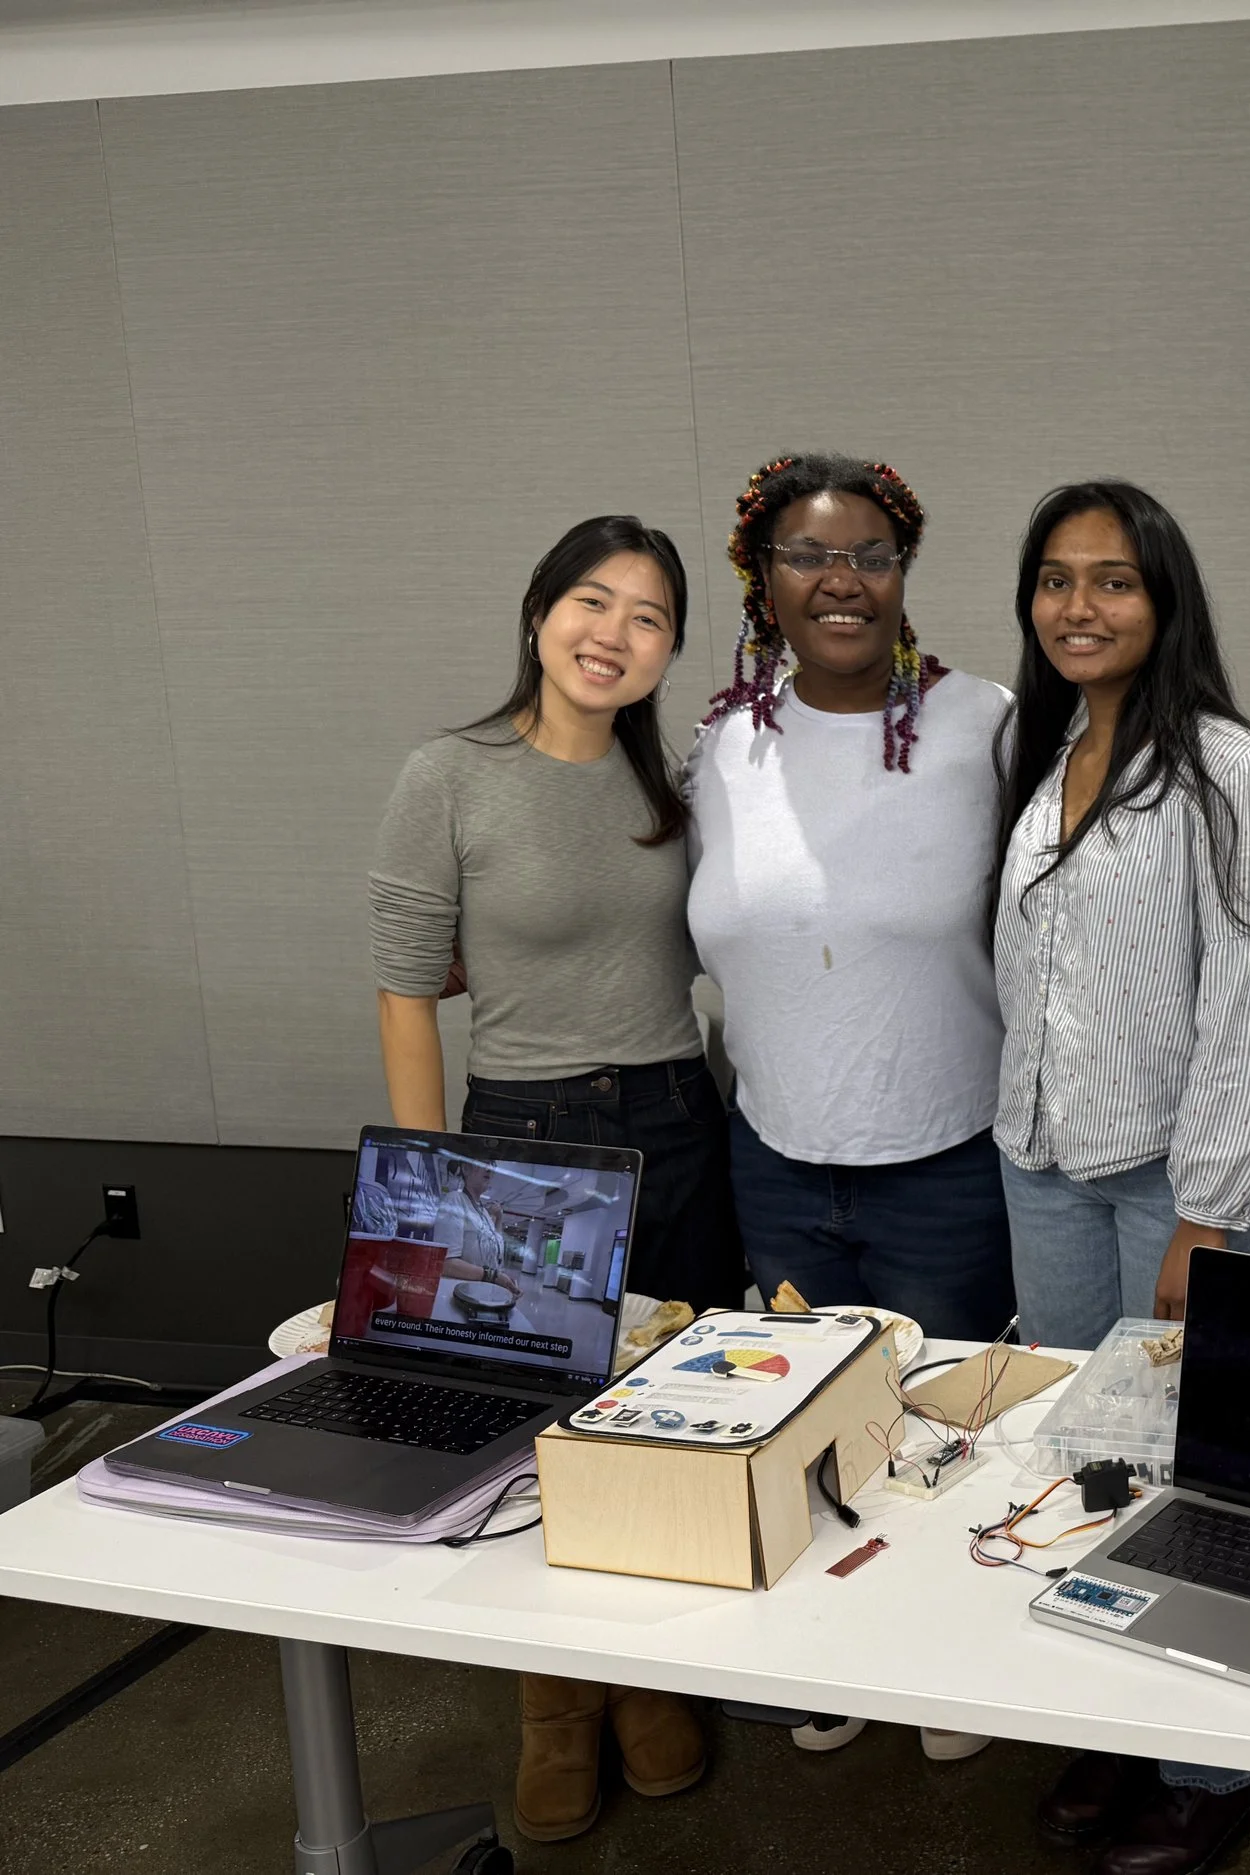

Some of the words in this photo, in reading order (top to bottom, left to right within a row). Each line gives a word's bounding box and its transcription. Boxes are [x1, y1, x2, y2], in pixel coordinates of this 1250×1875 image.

[375, 1318, 397, 1328] every
[398, 1321, 422, 1331] round.
[424, 1323, 444, 1334] Their
[445, 1327, 477, 1340] honesty
[478, 1331, 514, 1344] informed
[515, 1338, 529, 1346] our
[531, 1341, 549, 1350] next
[550, 1343, 568, 1353] step
